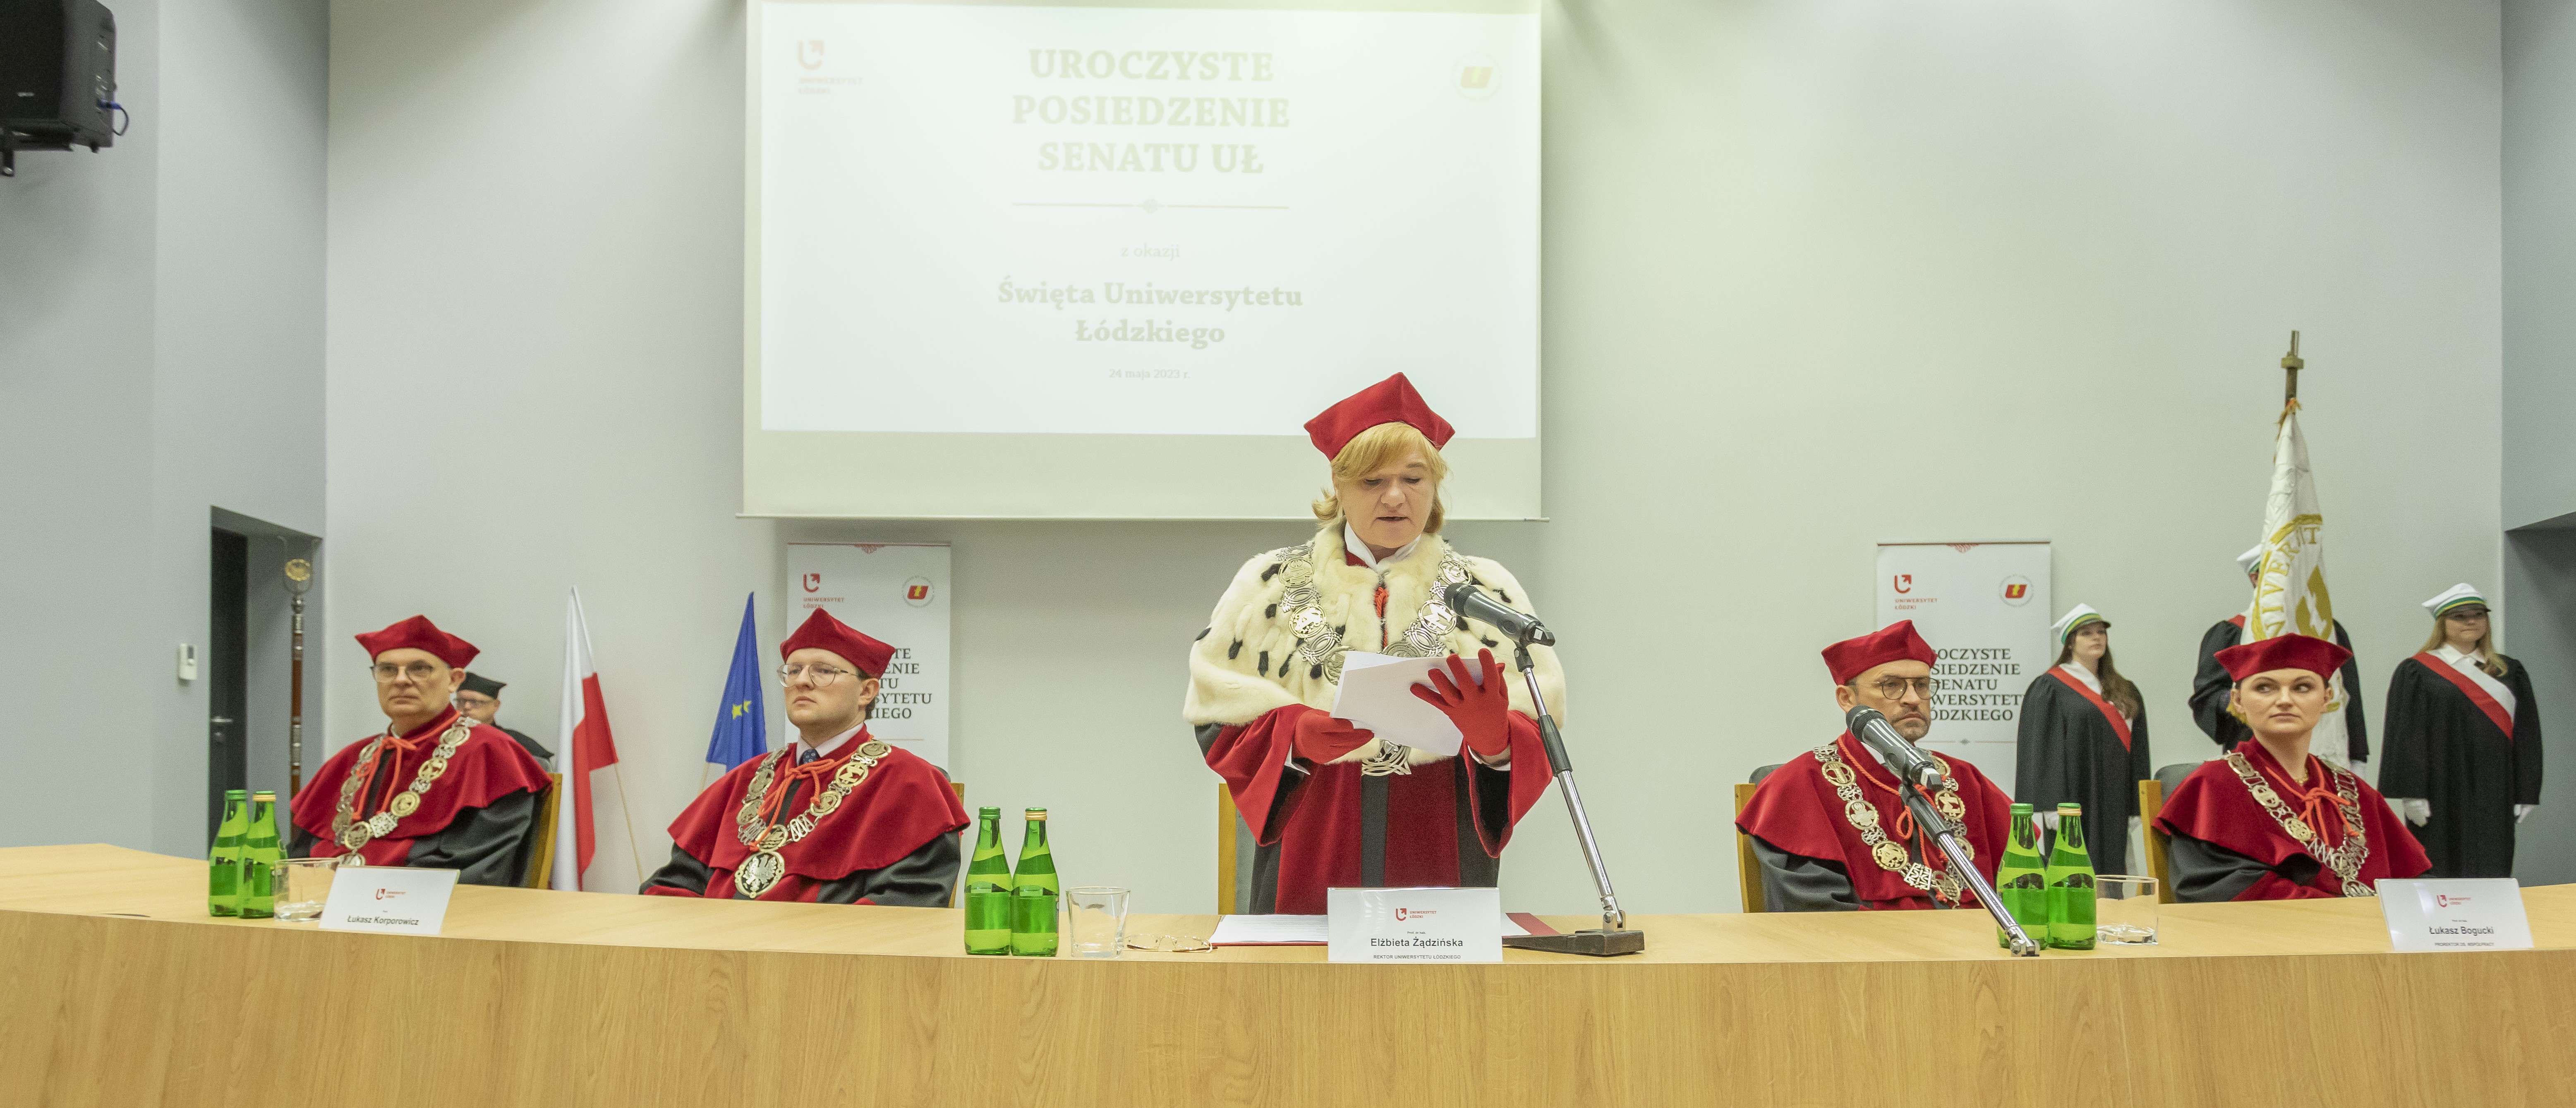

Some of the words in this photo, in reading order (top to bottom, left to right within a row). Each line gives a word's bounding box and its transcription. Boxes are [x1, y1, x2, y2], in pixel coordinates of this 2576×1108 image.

[1029, 49, 1274, 82] UROCZYSTE
[1013, 95, 1290, 128] POSIEDZENIE
[1038, 142, 1200, 173] SENATU
[1211, 144, 1264, 174] UŁ
[1120, 247, 1129, 257] z
[1133, 242, 1180, 262] okazji
[998, 275, 1095, 311] Święta
[1104, 282, 1303, 313] Uniwersytetu
[1076, 318, 1226, 350] Łódzkiego
[1109, 369, 1122, 378] 24
[1125, 370, 1151, 381] maja
[1154, 369, 1180, 379] 2023
[1935, 648, 2011, 660] OCZYSTE
[1931, 664, 2020, 675] SIEDZENIE
[1931, 694, 2024, 706] WERSYTET
[1931, 706, 2013, 721] ÓDZKIEGO
[374, 916, 419, 926] Korporowicz
[2429, 926, 2459, 934] Łukasz
[2460, 926, 2494, 936] Bogucki
[1371, 938, 1409, 947] Elżbieta
[1413, 936, 1463, 948] Żądzińska
